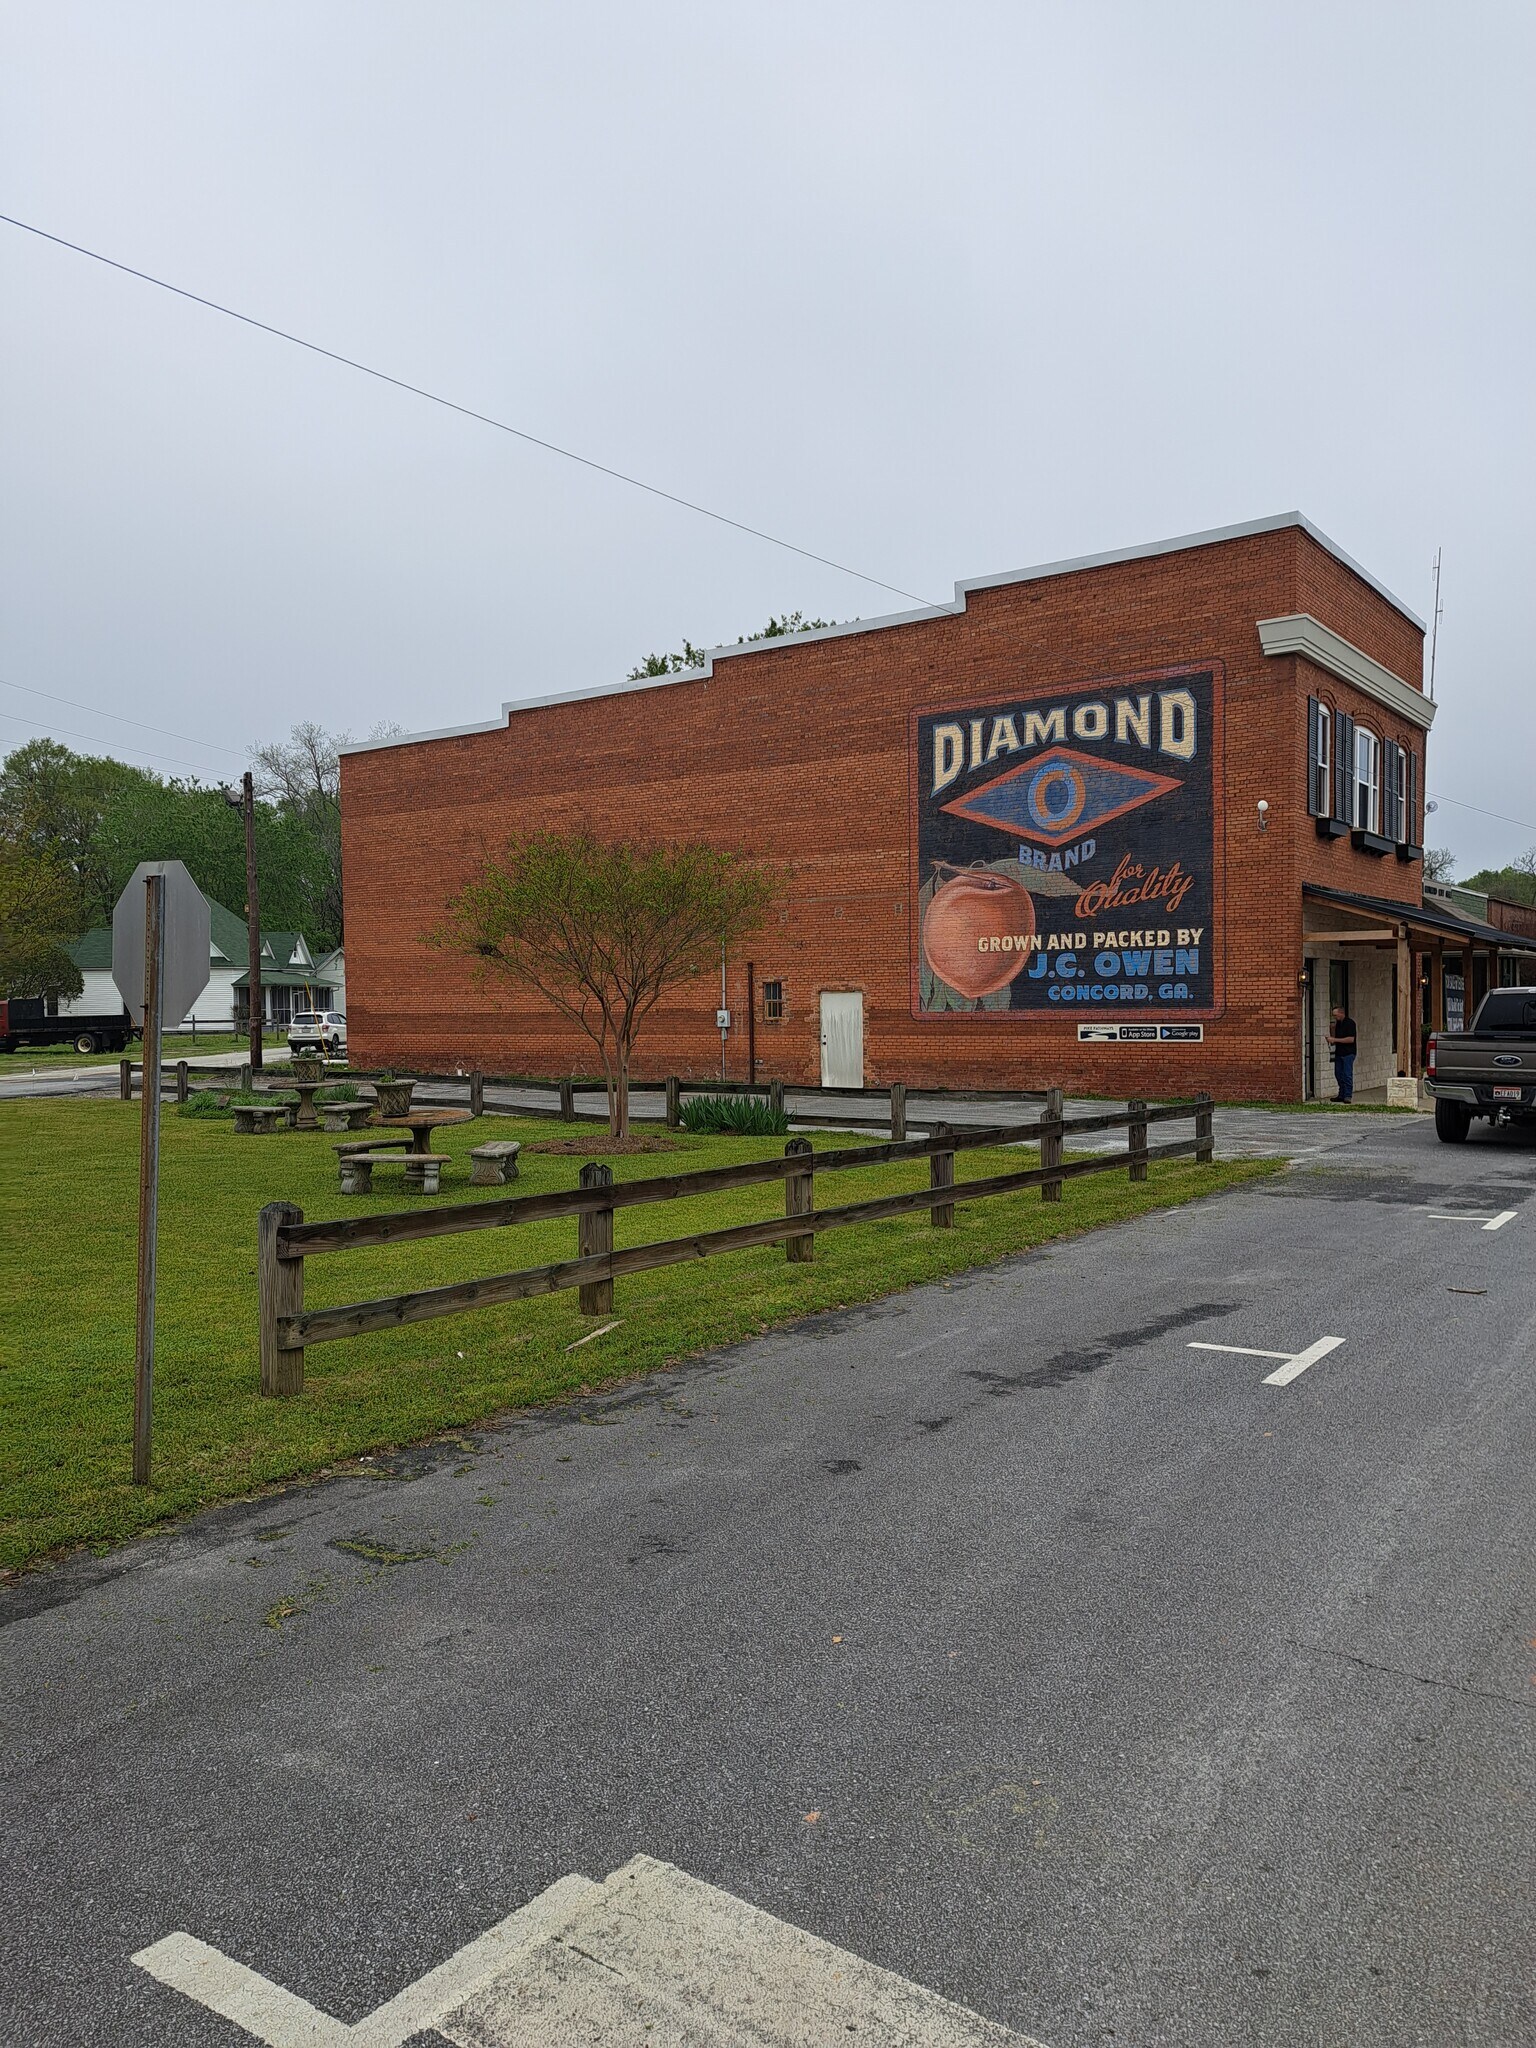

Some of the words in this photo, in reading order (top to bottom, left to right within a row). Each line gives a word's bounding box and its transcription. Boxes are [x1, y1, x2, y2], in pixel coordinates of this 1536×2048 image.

[930, 687, 1197, 798] DIAMOND
[1018, 839, 1096, 872] BRAND
[1111, 853, 1147, 882] for
[1075, 861, 1195, 918] Quality
[978, 935, 1042, 952] GROWN
[1047, 933, 1086, 950] AND
[1093, 930, 1170, 948] PACKED
[1177, 928, 1204, 946] BY
[1028, 953, 1085, 978] J.C.
[1094, 948, 1199, 976] OWEN
[1048, 983, 1153, 1002] CONCORD,
[1158, 983, 1194, 999] GA.
